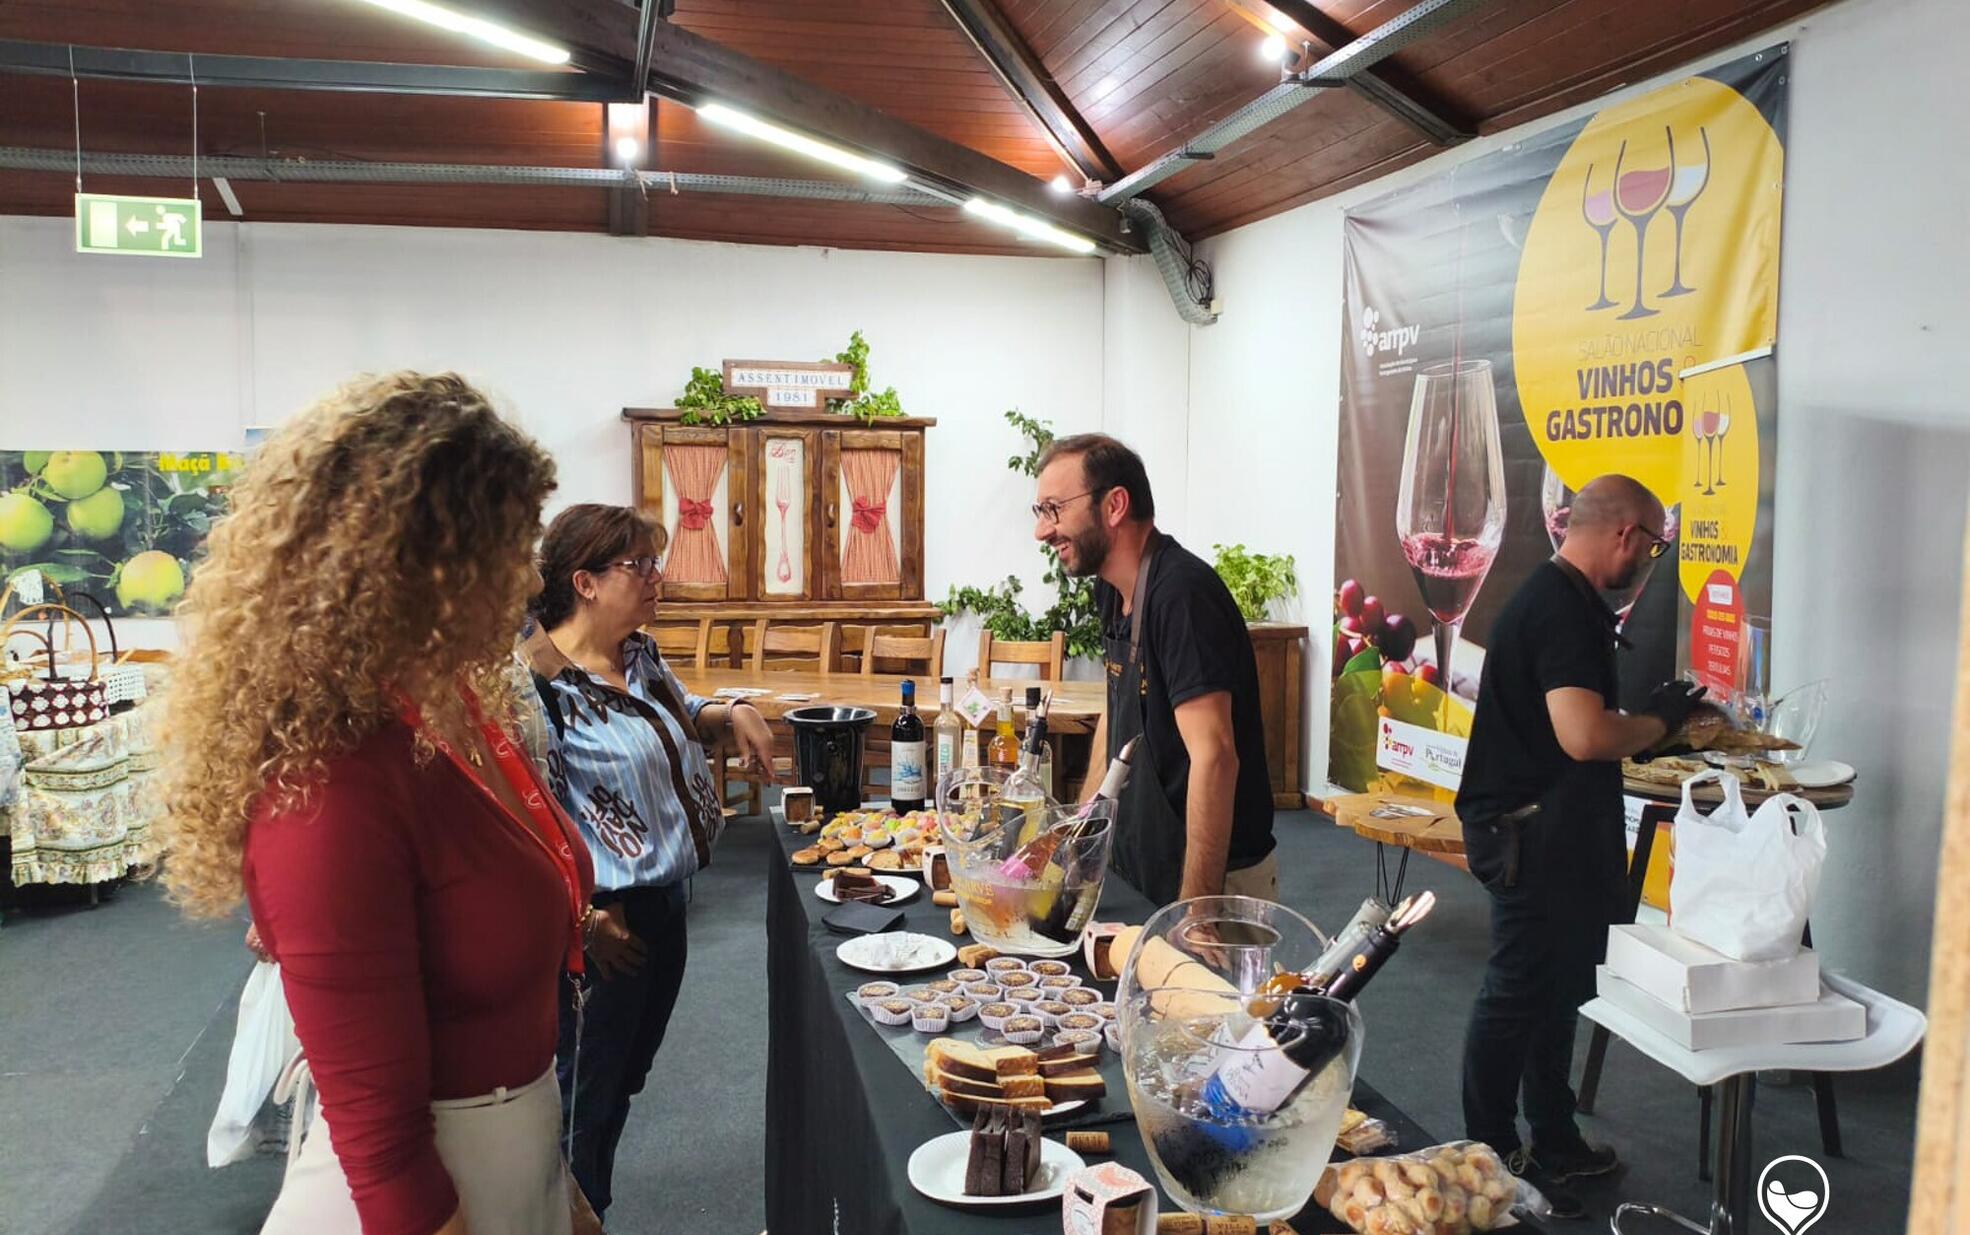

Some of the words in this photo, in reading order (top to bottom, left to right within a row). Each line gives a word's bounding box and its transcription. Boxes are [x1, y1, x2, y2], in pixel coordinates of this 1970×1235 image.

[1624, 324, 1704, 354] NACIONAL
[1577, 358, 1673, 400] VINHOS
[774, 392, 809, 403] 1981
[158, 452, 211, 476] Maçã
[1690, 519, 1719, 540] VINHOS
[1680, 541, 1738, 565] GASTRONOMIA
